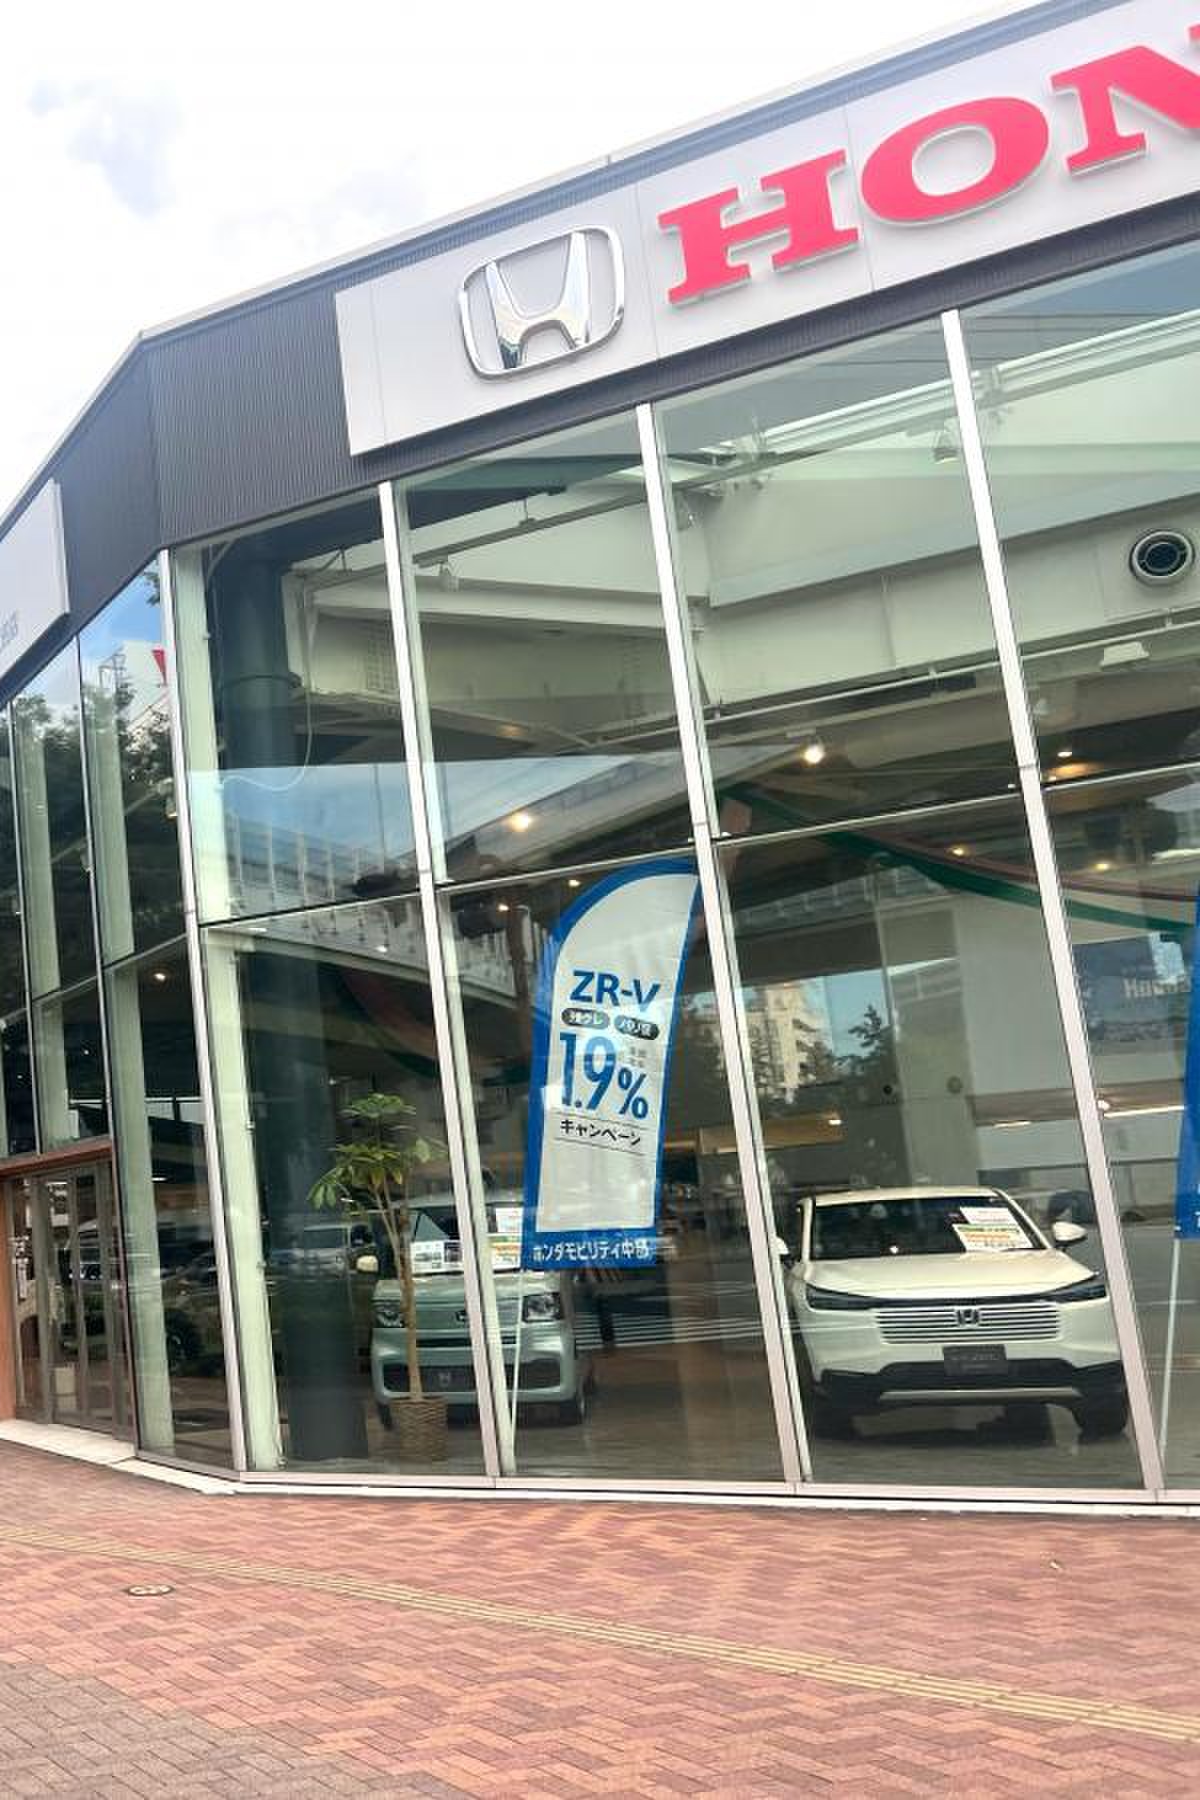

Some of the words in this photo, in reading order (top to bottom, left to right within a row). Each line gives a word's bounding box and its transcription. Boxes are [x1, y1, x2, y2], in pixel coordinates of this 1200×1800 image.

[569, 969, 661, 1012] ZR-V
[559, 1032, 649, 1119] 1.9%
[560, 1119, 641, 1147] キャンペーン
